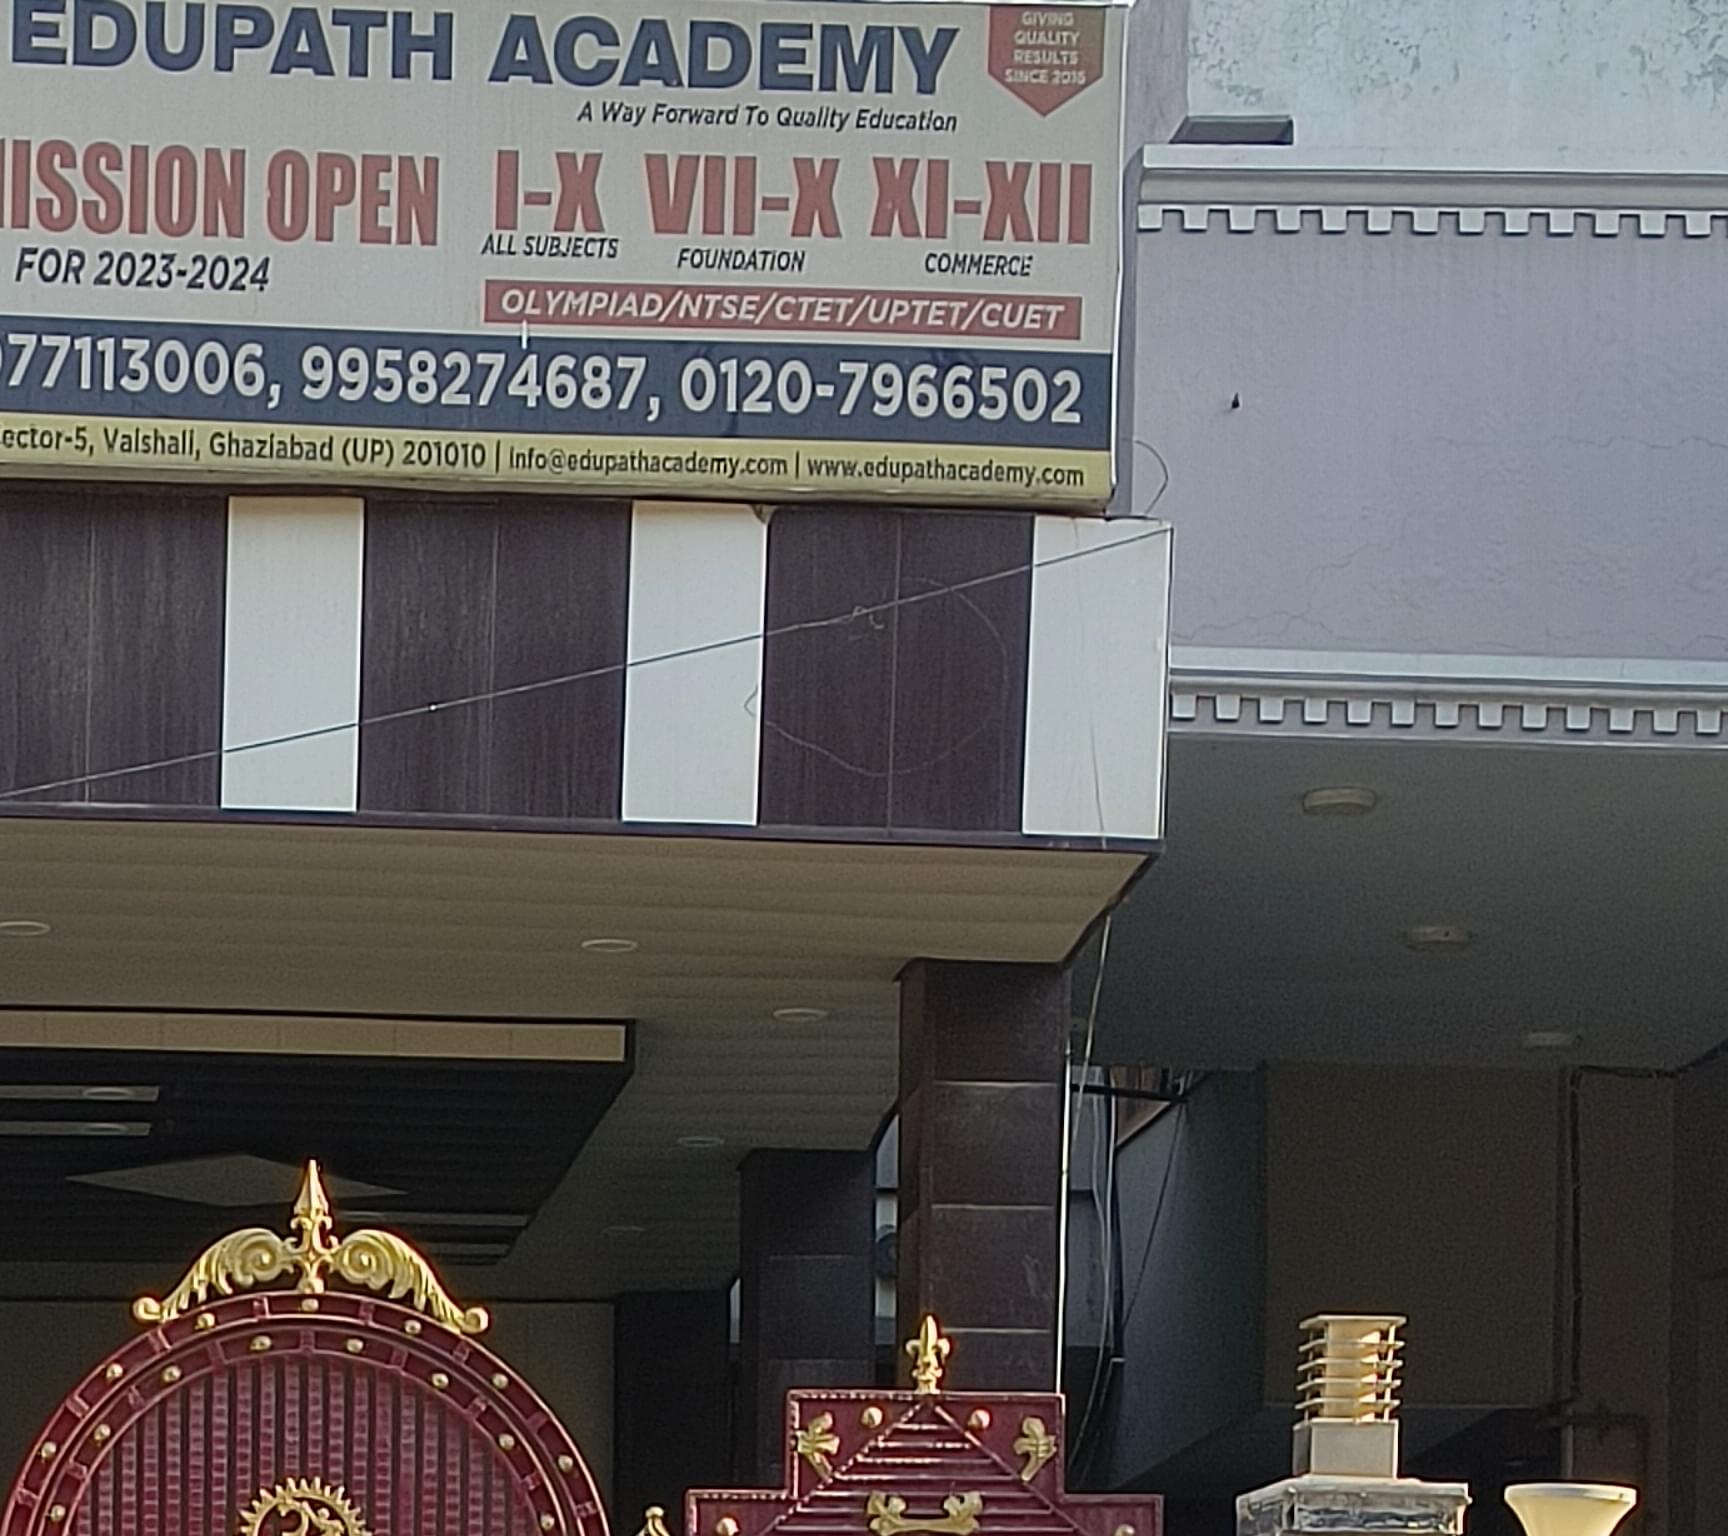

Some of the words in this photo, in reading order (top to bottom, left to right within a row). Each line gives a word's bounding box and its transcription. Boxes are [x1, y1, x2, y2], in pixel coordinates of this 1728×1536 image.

[1021, 11, 1075, 27] GIVING
[12, 0, 454, 80] EDUPATH
[488, 14, 960, 95] ACADEMY
[1013, 30, 1080, 47] QUALITY
[1012, 49, 1079, 66] RESULTS
[1004, 68, 1049, 85] SINCE
[578, 102, 594, 122] A
[602, 103, 648, 127] Way
[652, 104, 740, 126] Forward
[745, 107, 770, 127] To
[776, 107, 849, 133] Quality
[855, 109, 958, 132] Education
[266, 148, 440, 247] OPEN
[495, 149, 605, 234] I-X
[643, 153, 843, 239] VII-X
[869, 155, 1093, 245] XI-XII
[480, 233, 518, 257] ALL
[522, 235, 620, 259] SUBJECTS
[676, 248, 806, 273] FOUNDATION
[14, 247, 86, 285] FOR
[93, 250, 271, 293] 2023-2024
[924, 252, 1034, 277] COMMERCE
[501, 287, 1066, 331] OLYMPIAD/NTSE/CTET/UPTET/CUET
[300, 344, 661, 422] 9958274687,
[679, 356, 1083, 425] 0120-7966502
[208, 432, 334, 463] Ghaziabad
[341, 438, 395, 468] (UP)
[401, 440, 486, 469] 201010
[508, 445, 789, 481] info@edupathacademy.com
[807, 456, 1085, 489] www.edupathacademy.com
